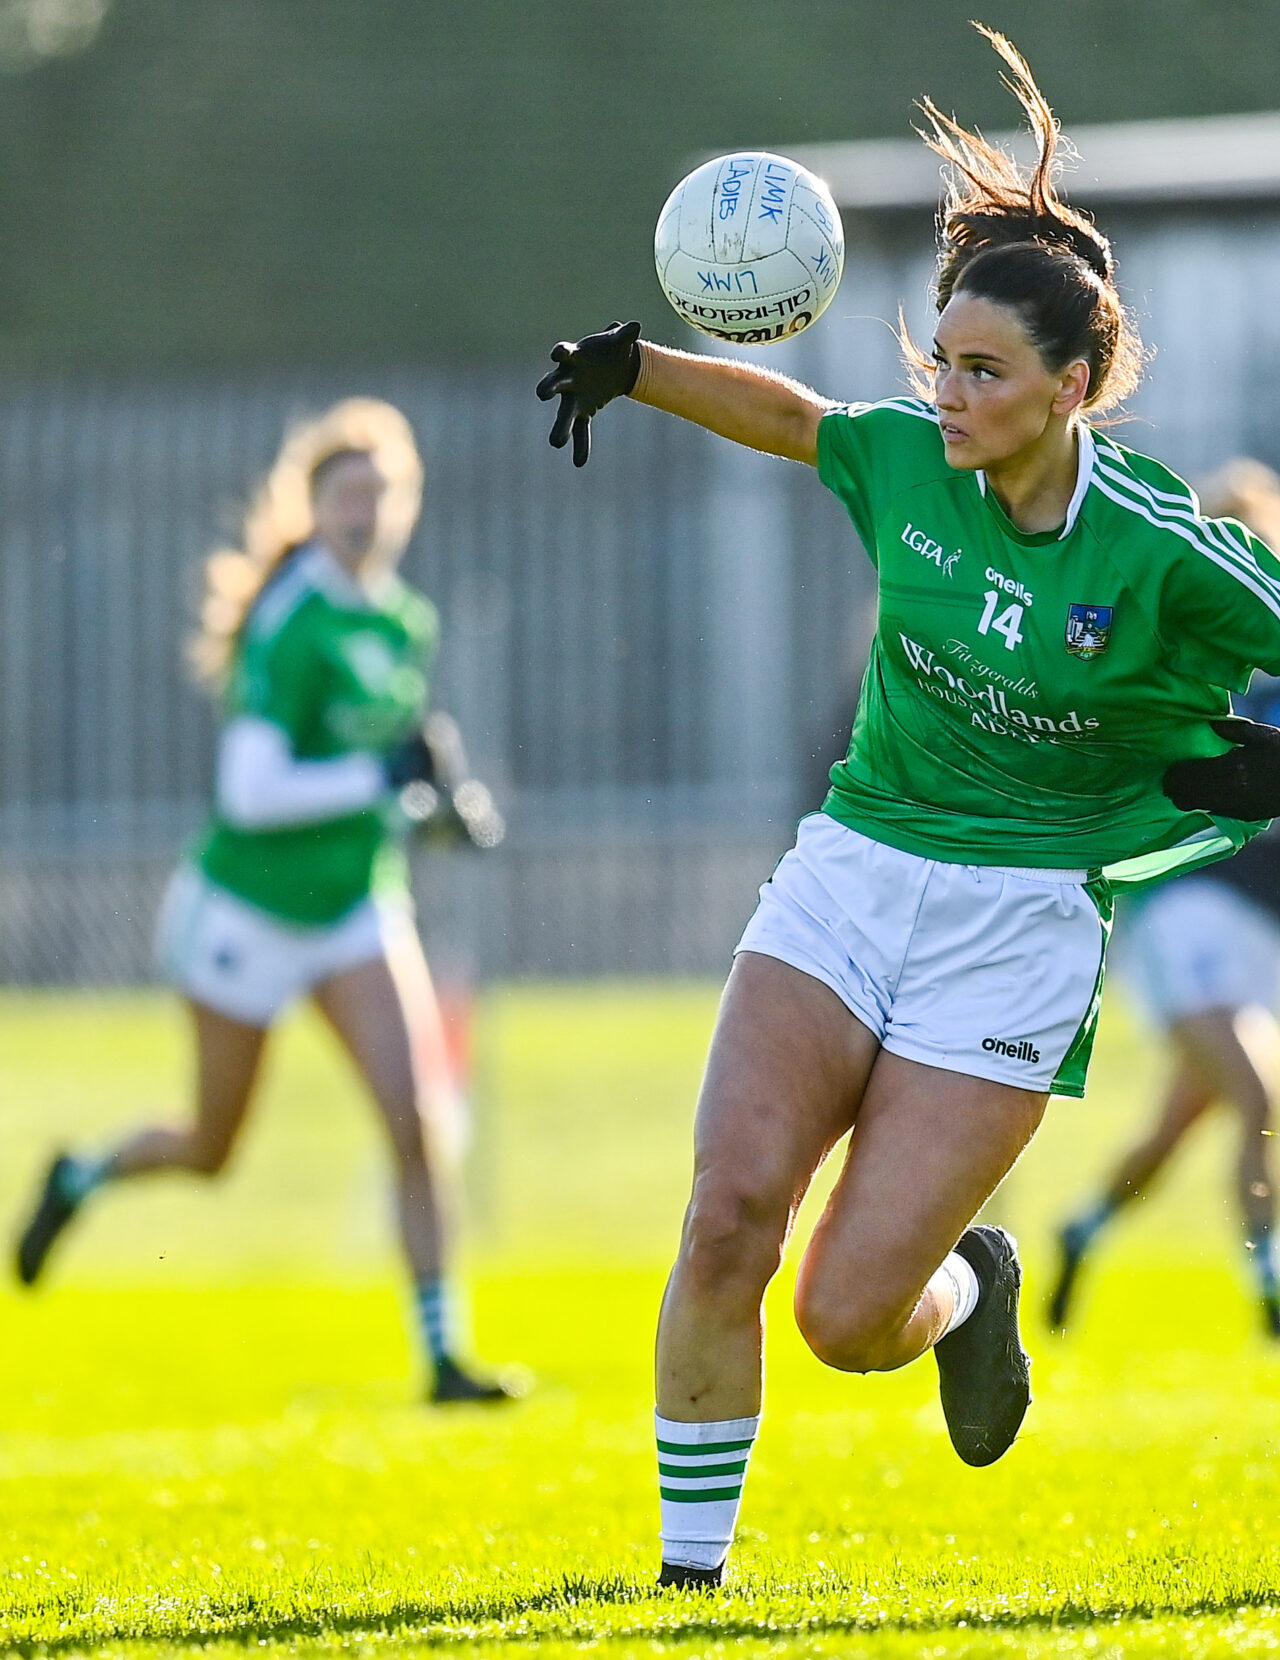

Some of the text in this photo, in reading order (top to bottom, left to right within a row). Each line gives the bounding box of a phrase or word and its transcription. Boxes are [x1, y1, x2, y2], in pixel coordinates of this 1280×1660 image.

[719, 159, 754, 220] LADIES
[758, 163, 792, 225] LIMK
[697, 270, 758, 294] LIMK
[900, 521, 943, 568] LGFA
[976, 589, 1024, 651] 14
[898, 631, 1100, 734] Woodlands
[917, 677, 975, 711] HOUS
